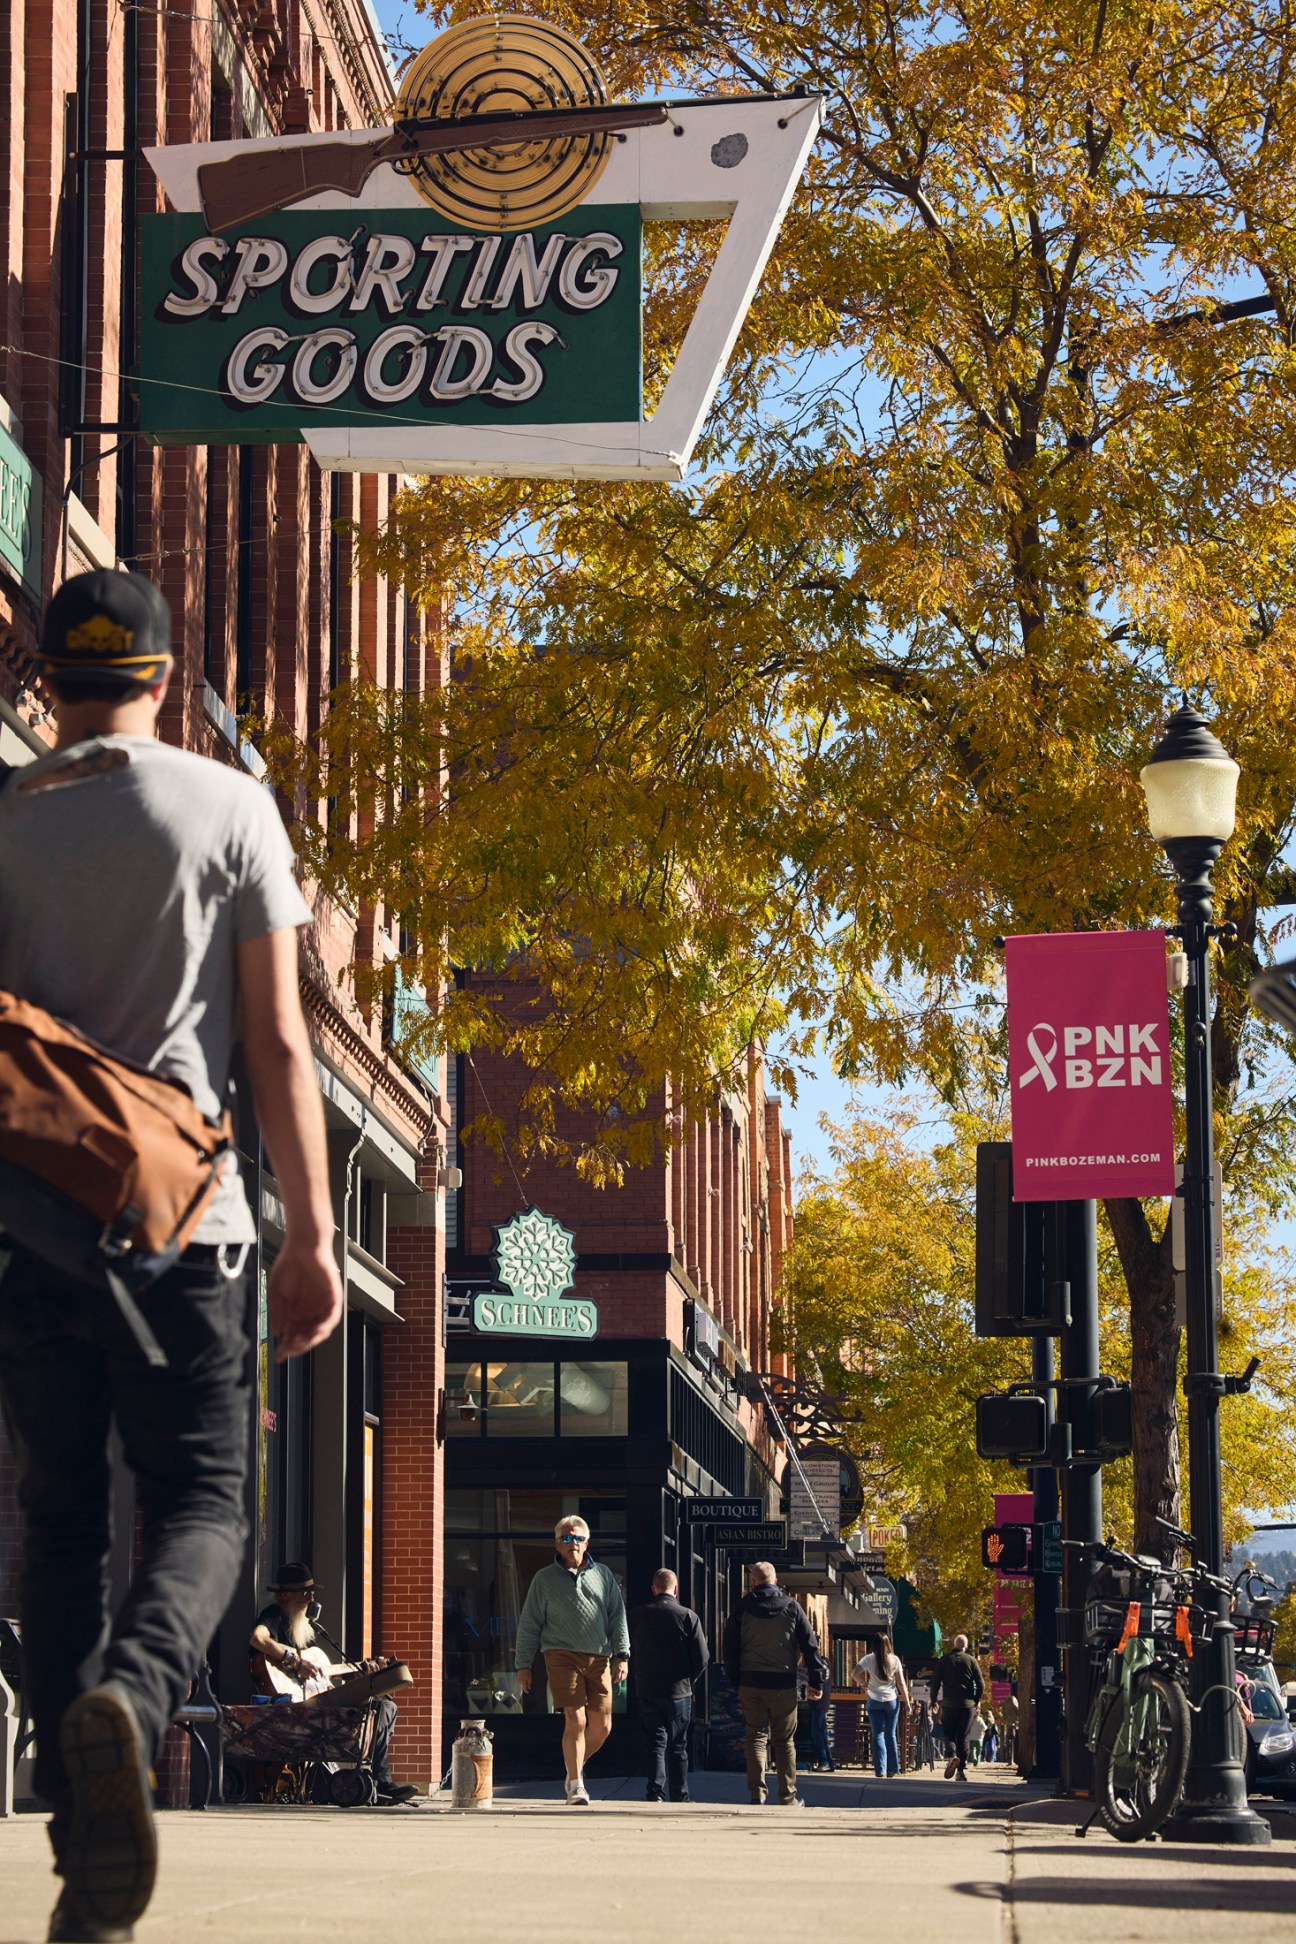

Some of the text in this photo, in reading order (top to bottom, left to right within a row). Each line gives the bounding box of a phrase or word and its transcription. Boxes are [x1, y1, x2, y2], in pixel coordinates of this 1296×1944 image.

[163, 231, 624, 317] SPORTING
[226, 321, 557, 404] GOODS
[1063, 1023, 1161, 1056] PNK
[1064, 1056, 1162, 1089] BZN
[1025, 1152, 1161, 1168] PINKBOZEMAN.COM
[481, 1299, 593, 1333] SCHNEE'S
[691, 1505, 759, 1518] BOUTIQUE
[718, 1529, 782, 1540] ASIAN BISTRO
